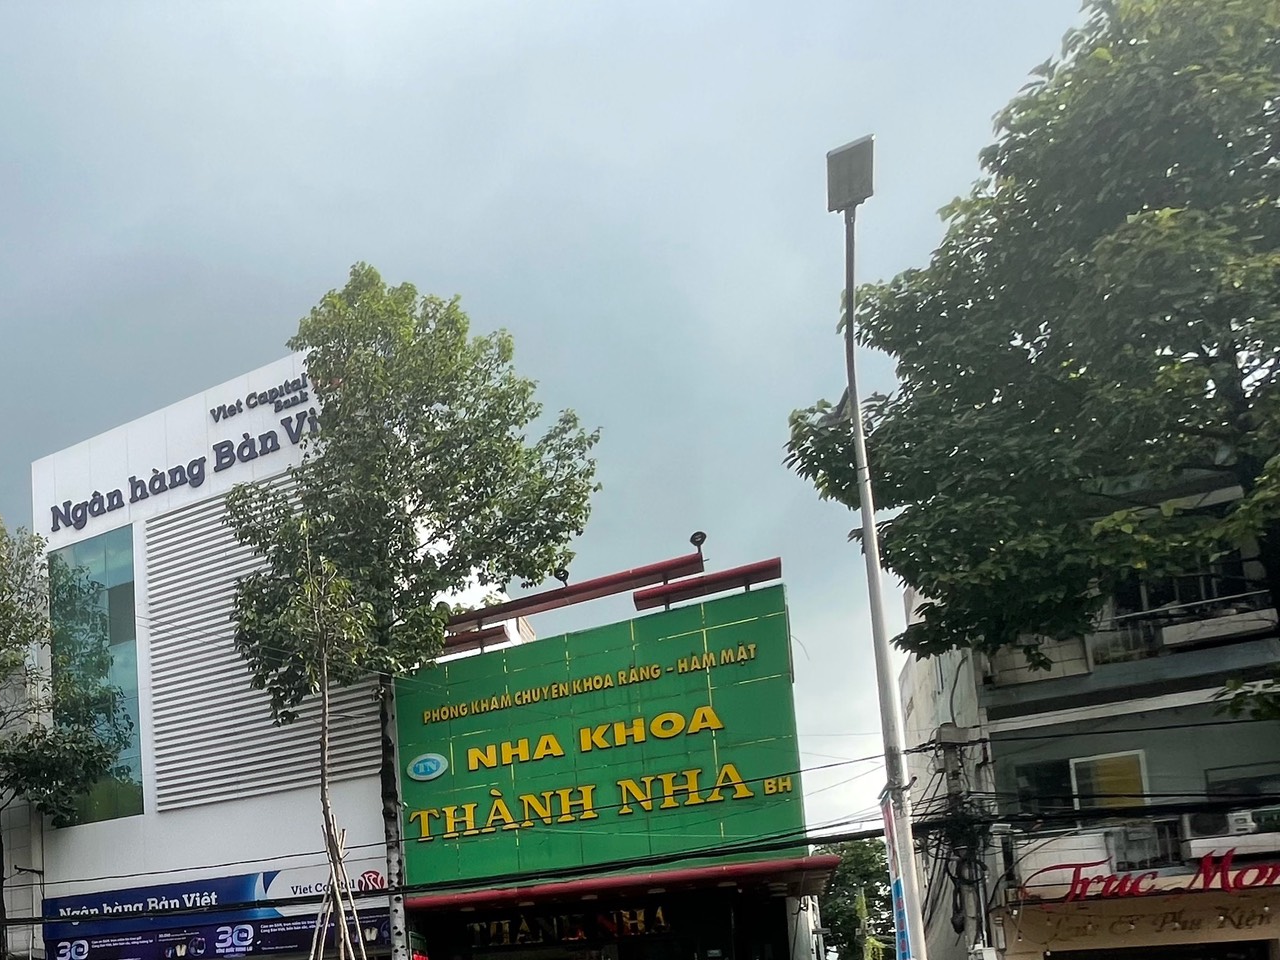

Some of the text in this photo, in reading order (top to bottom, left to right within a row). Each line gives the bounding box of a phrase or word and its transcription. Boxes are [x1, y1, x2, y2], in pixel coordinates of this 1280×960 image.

[210, 372, 308, 423] Viet Capital
[273, 390, 309, 413] Bank
[51, 407, 319, 532] Ngân hàng Bản Vi
[514, 682, 570, 706] CHUYÊN
[571, 673, 615, 694] KHOA
[617, 663, 662, 686] RĂNG
[720, 642, 757, 667] MẶT
[467, 705, 724, 771] NHA KHOA
[408, 763, 792, 842] THÀNH NHA BH
[291, 883, 312, 896] Viet
